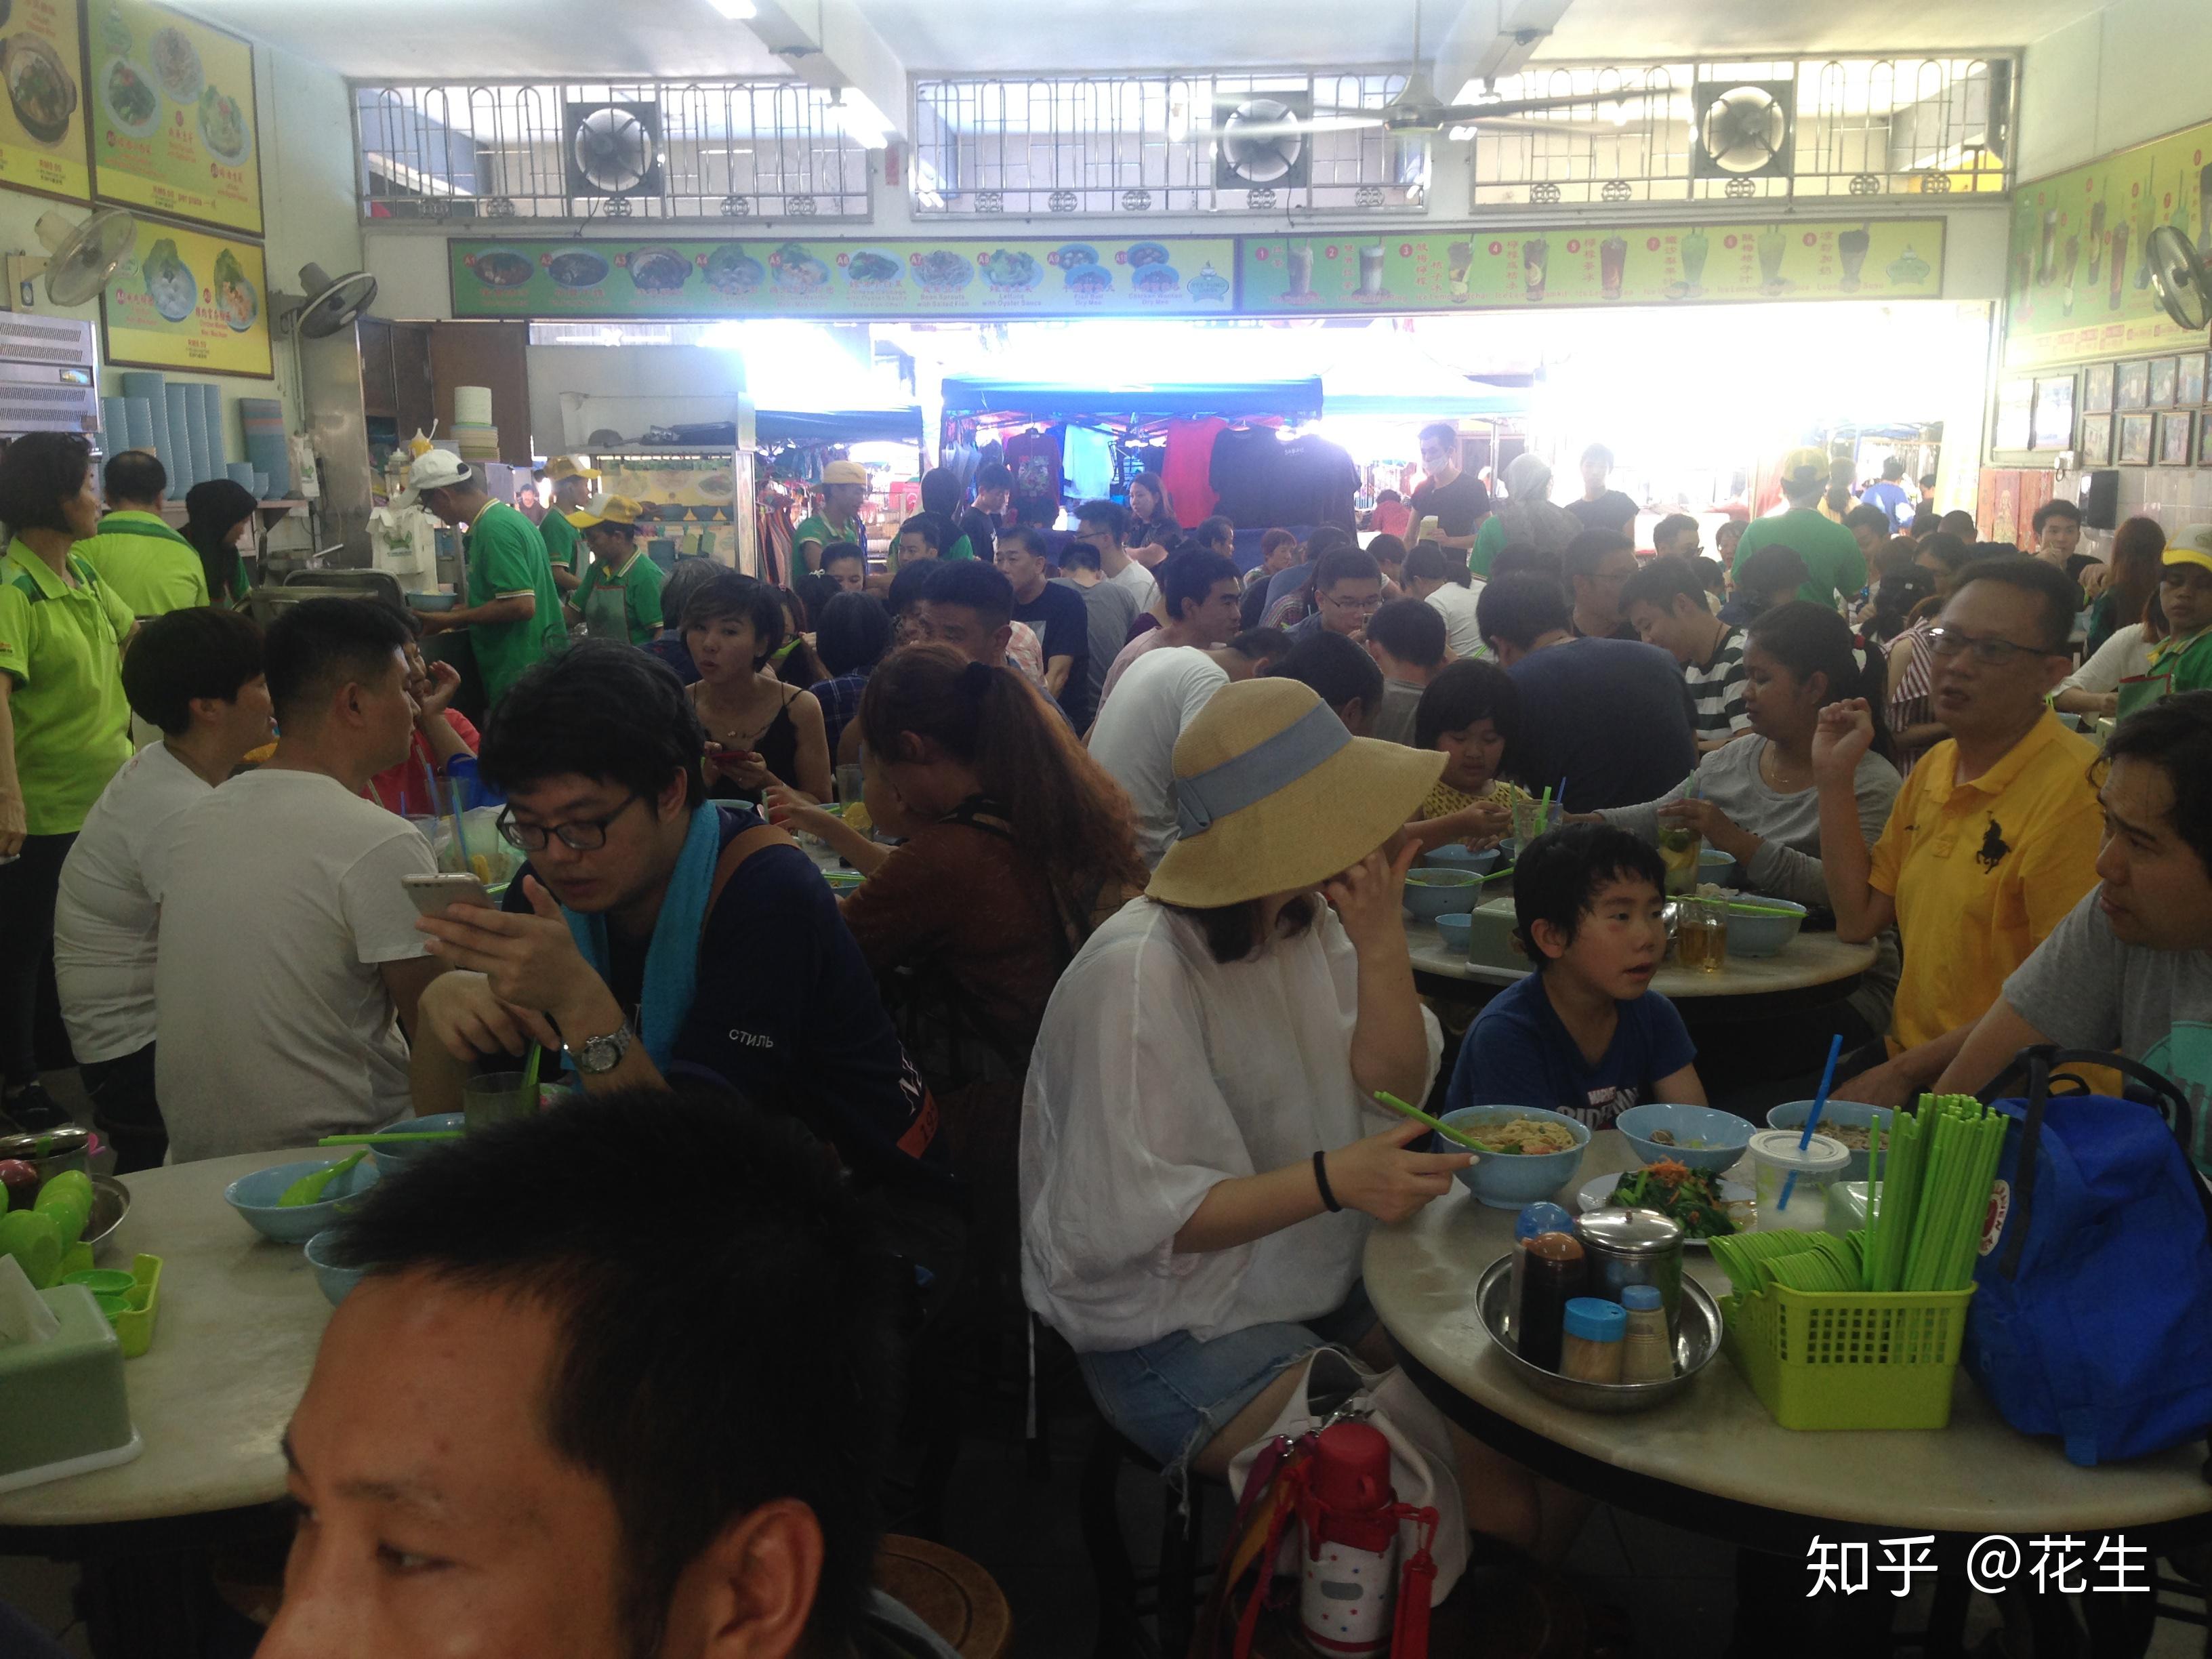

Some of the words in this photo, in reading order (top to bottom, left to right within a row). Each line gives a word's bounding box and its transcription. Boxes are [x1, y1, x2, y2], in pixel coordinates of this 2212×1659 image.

[697, 256, 708, 264] A4
[770, 256, 781, 264] A5
[838, 256, 848, 264] A6
[911, 255, 922, 264] A7
[979, 255, 989, 264] A8
[1048, 254, 1059, 262] A9
